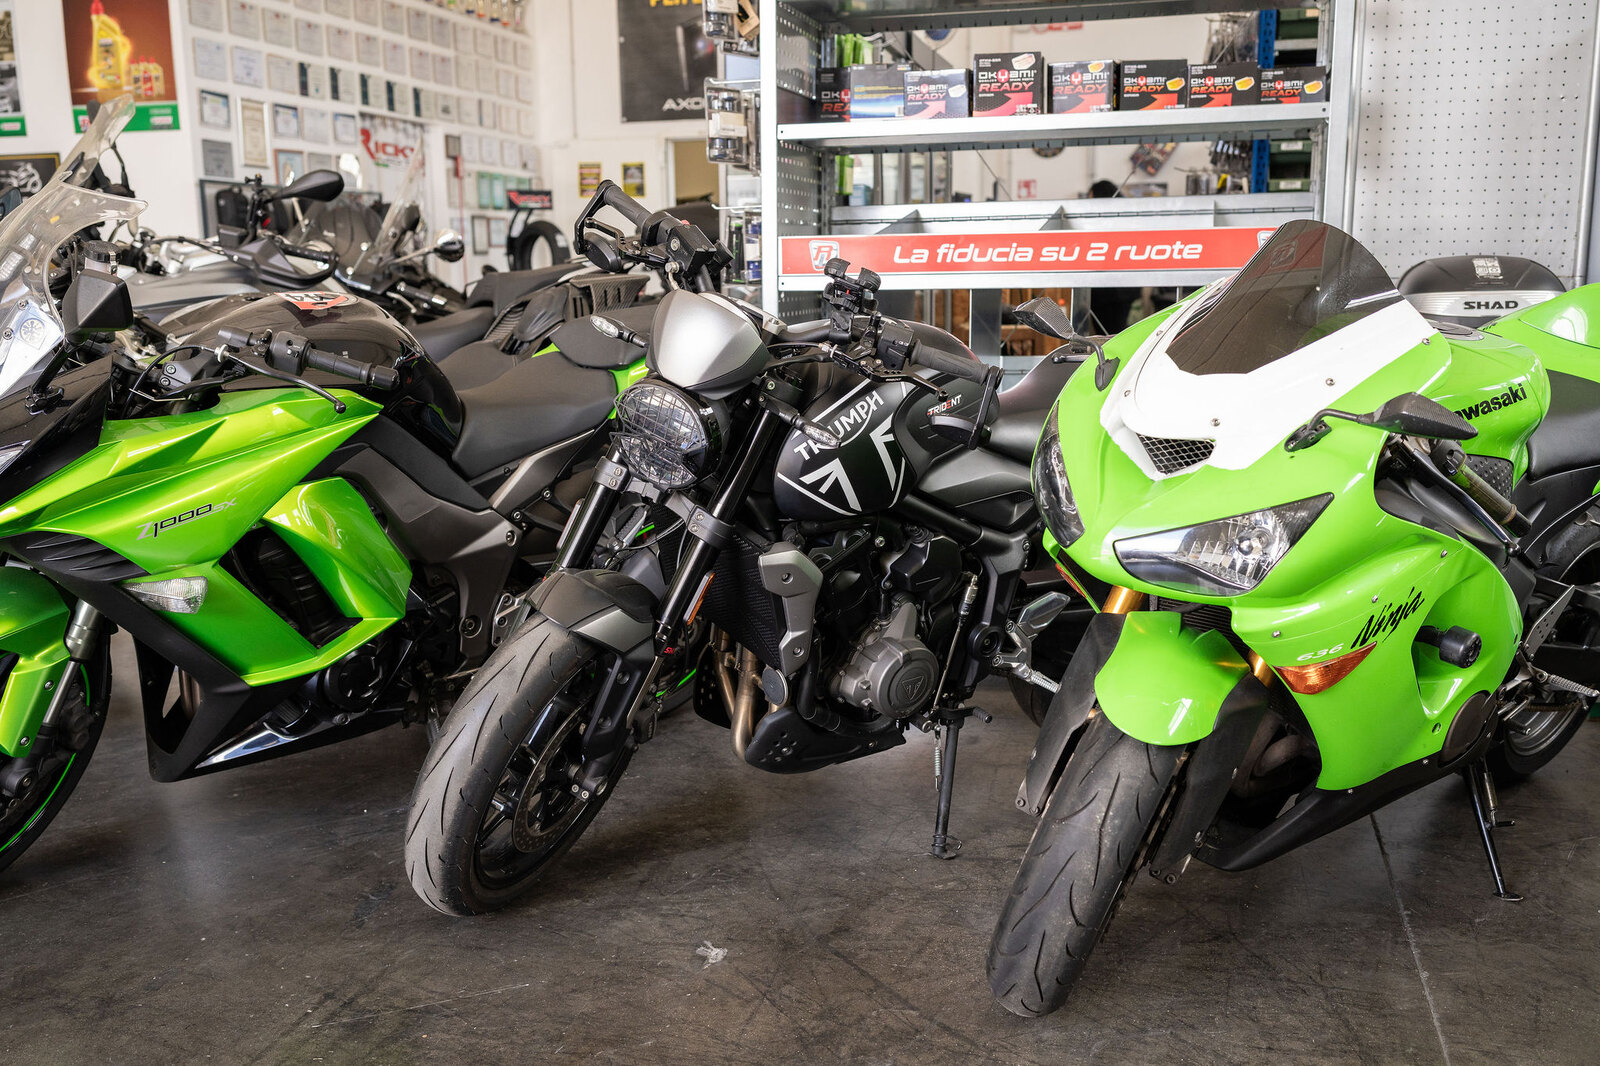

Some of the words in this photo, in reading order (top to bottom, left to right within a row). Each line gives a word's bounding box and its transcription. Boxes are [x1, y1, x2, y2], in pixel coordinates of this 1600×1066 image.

[979, 81, 1034, 92] READY
[1053, 83, 1107, 95] READY
[1124, 85, 1165, 93] READY
[1191, 85, 1233, 94] READY
[907, 92, 946, 101] READY
[1261, 89, 1302, 97] READY
[821, 102, 851, 112] REA
[893, 245, 930, 263] La
[936, 242, 1034, 263] fiducia
[1039, 246, 1081, 262] su
[1086, 242, 1109, 261] 2
[1114, 240, 1203, 261] ruote
[1463, 300, 1519, 310] SHAD
[927, 394, 962, 416] TRIDENT
[1453, 383, 1528, 421] wasaki
[1350, 586, 1425, 650] Ninja
[1297, 643, 1345, 661] 636
